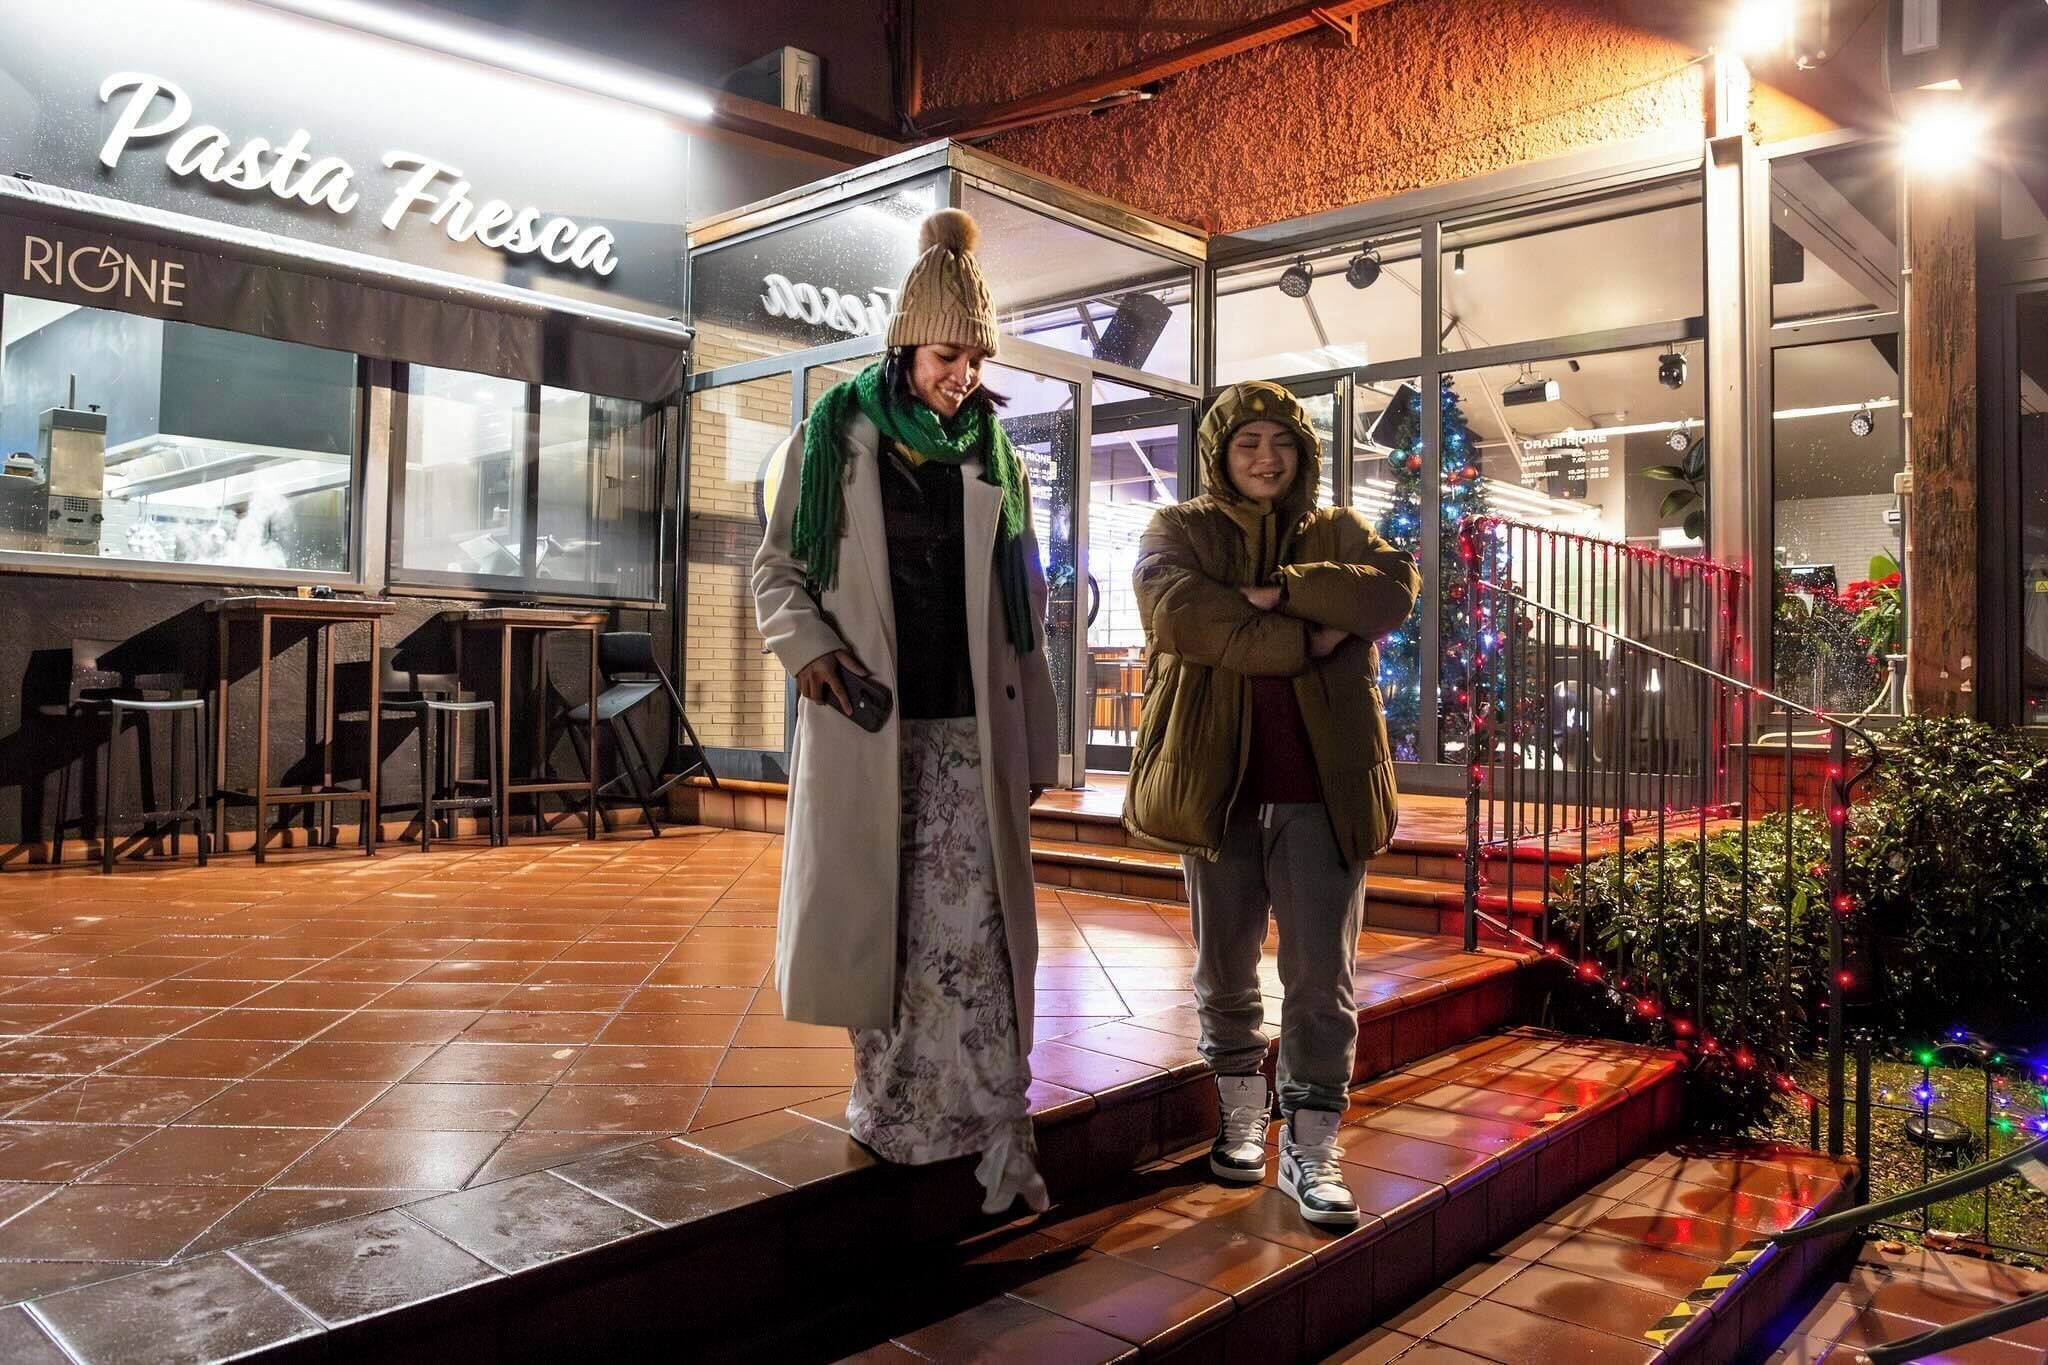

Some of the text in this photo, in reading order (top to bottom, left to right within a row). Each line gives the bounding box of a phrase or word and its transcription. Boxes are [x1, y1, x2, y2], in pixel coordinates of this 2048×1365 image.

[99, 71, 619, 276] Pasta Fresca
[24, 235, 186, 308] RIONE
